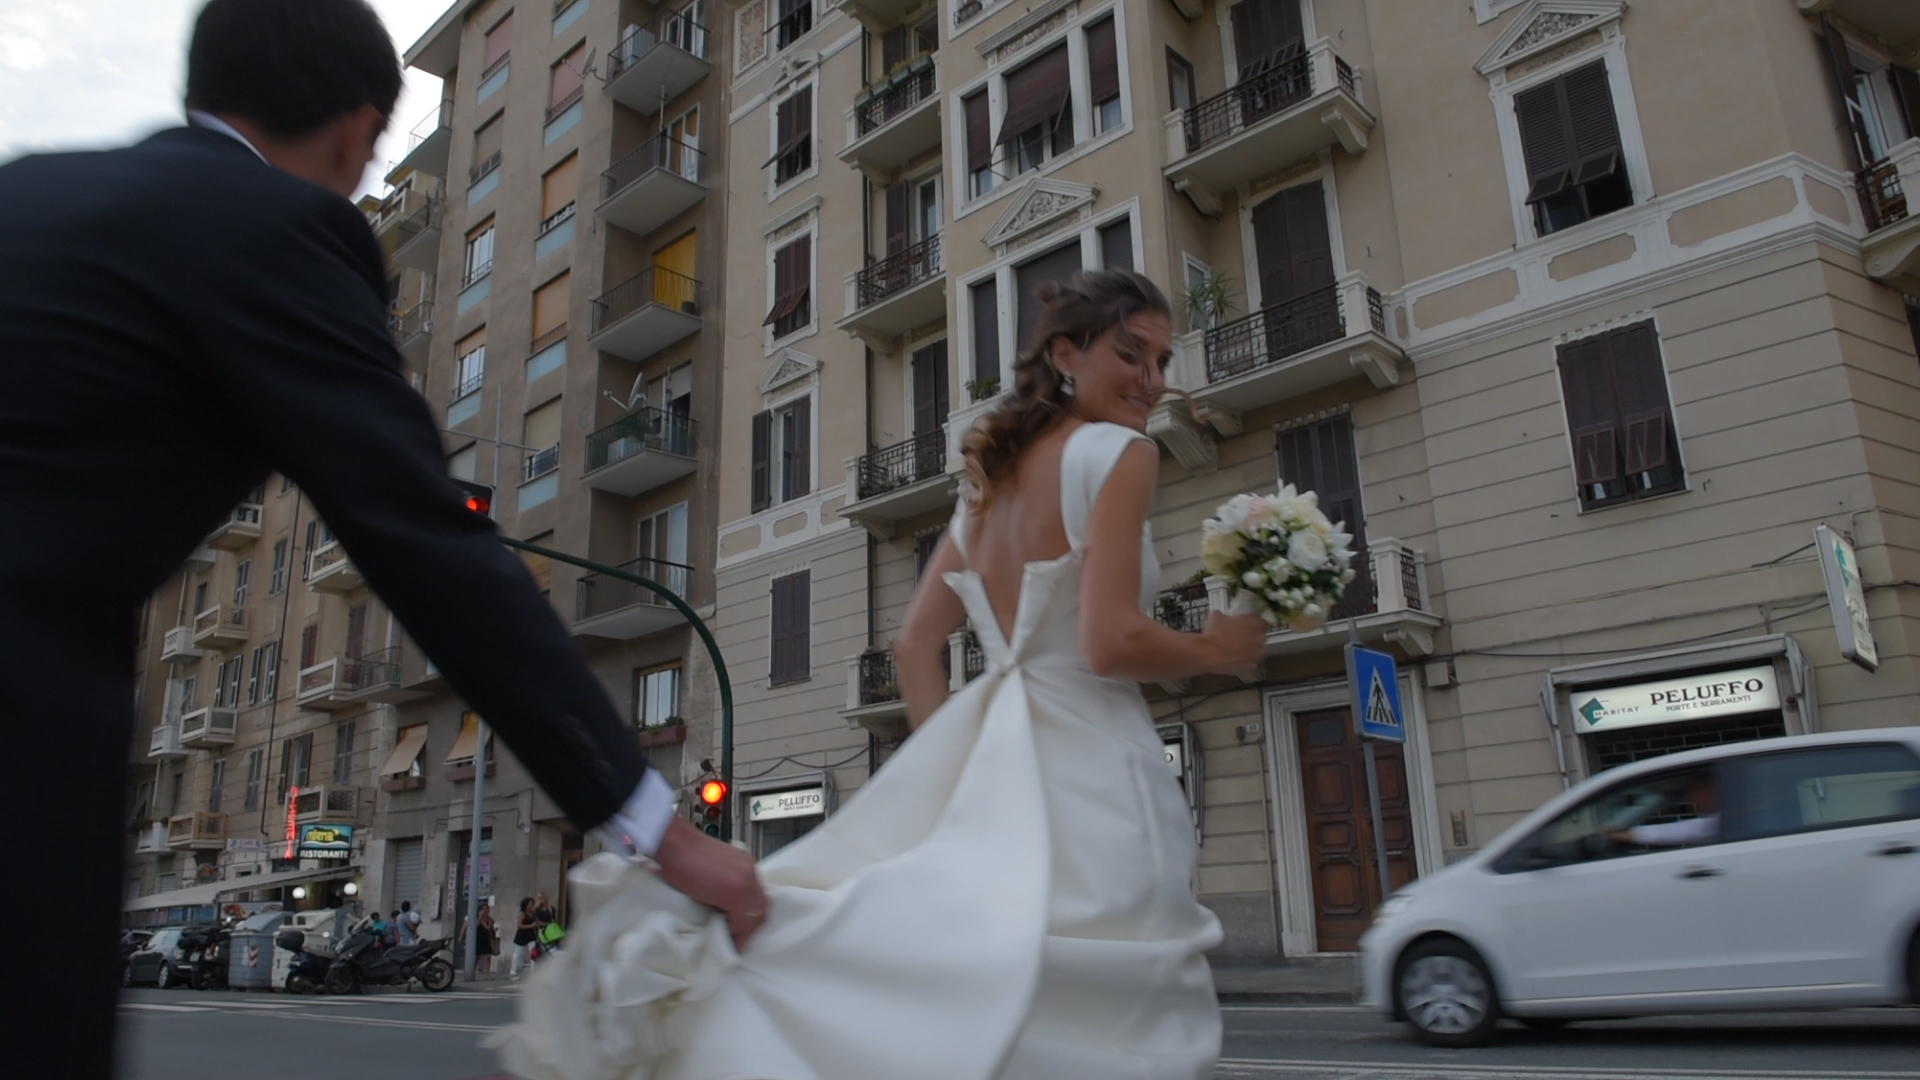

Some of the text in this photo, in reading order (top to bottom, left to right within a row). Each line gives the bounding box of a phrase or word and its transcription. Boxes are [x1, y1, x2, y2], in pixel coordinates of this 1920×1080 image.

[1649, 678, 1763, 706] PELUFFO
[1666, 702, 1691, 712] PORTE
[1700, 695, 1751, 708] SERRAMENTI
[1594, 706, 1639, 717] HABITAT
[778, 794, 820, 807] PELUFFO
[300, 849, 348, 859] RISTORANTE
